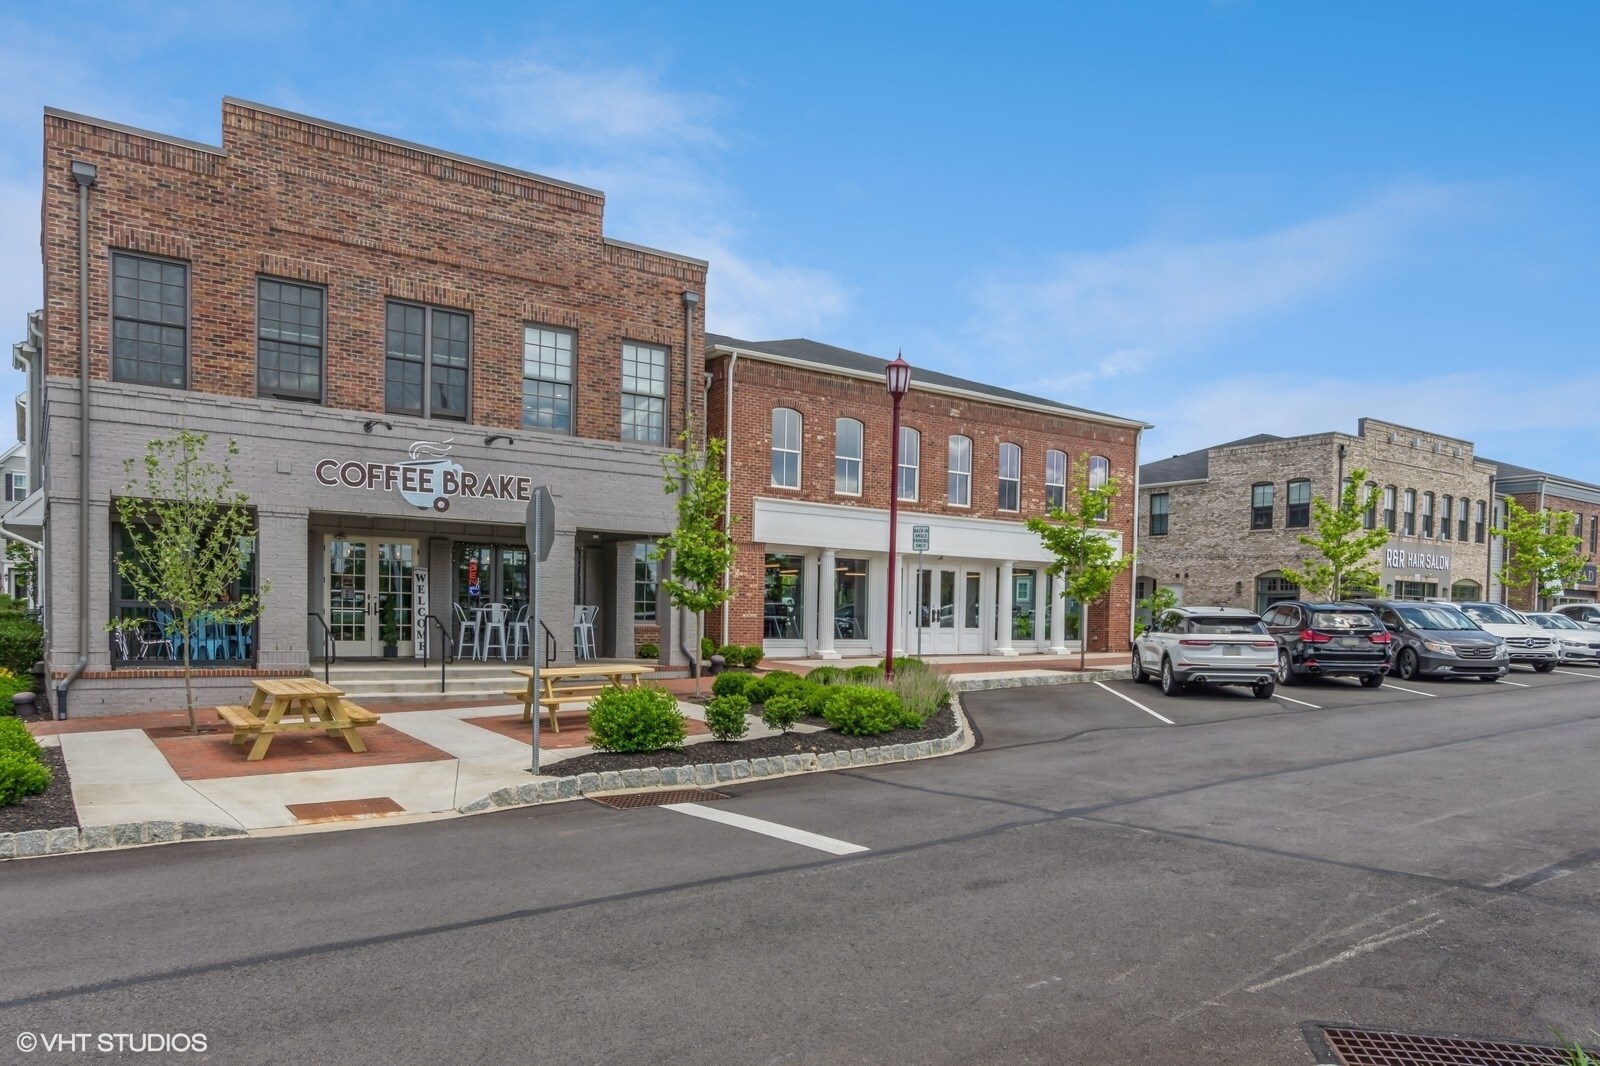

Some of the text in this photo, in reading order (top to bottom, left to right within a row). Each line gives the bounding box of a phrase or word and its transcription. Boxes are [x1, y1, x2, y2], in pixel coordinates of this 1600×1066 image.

[315, 458, 531, 501] COFFEE BRAKE
[1386, 549, 1449, 570] R&R HAIR SALON
[415, 573, 426, 651] WELCOME
